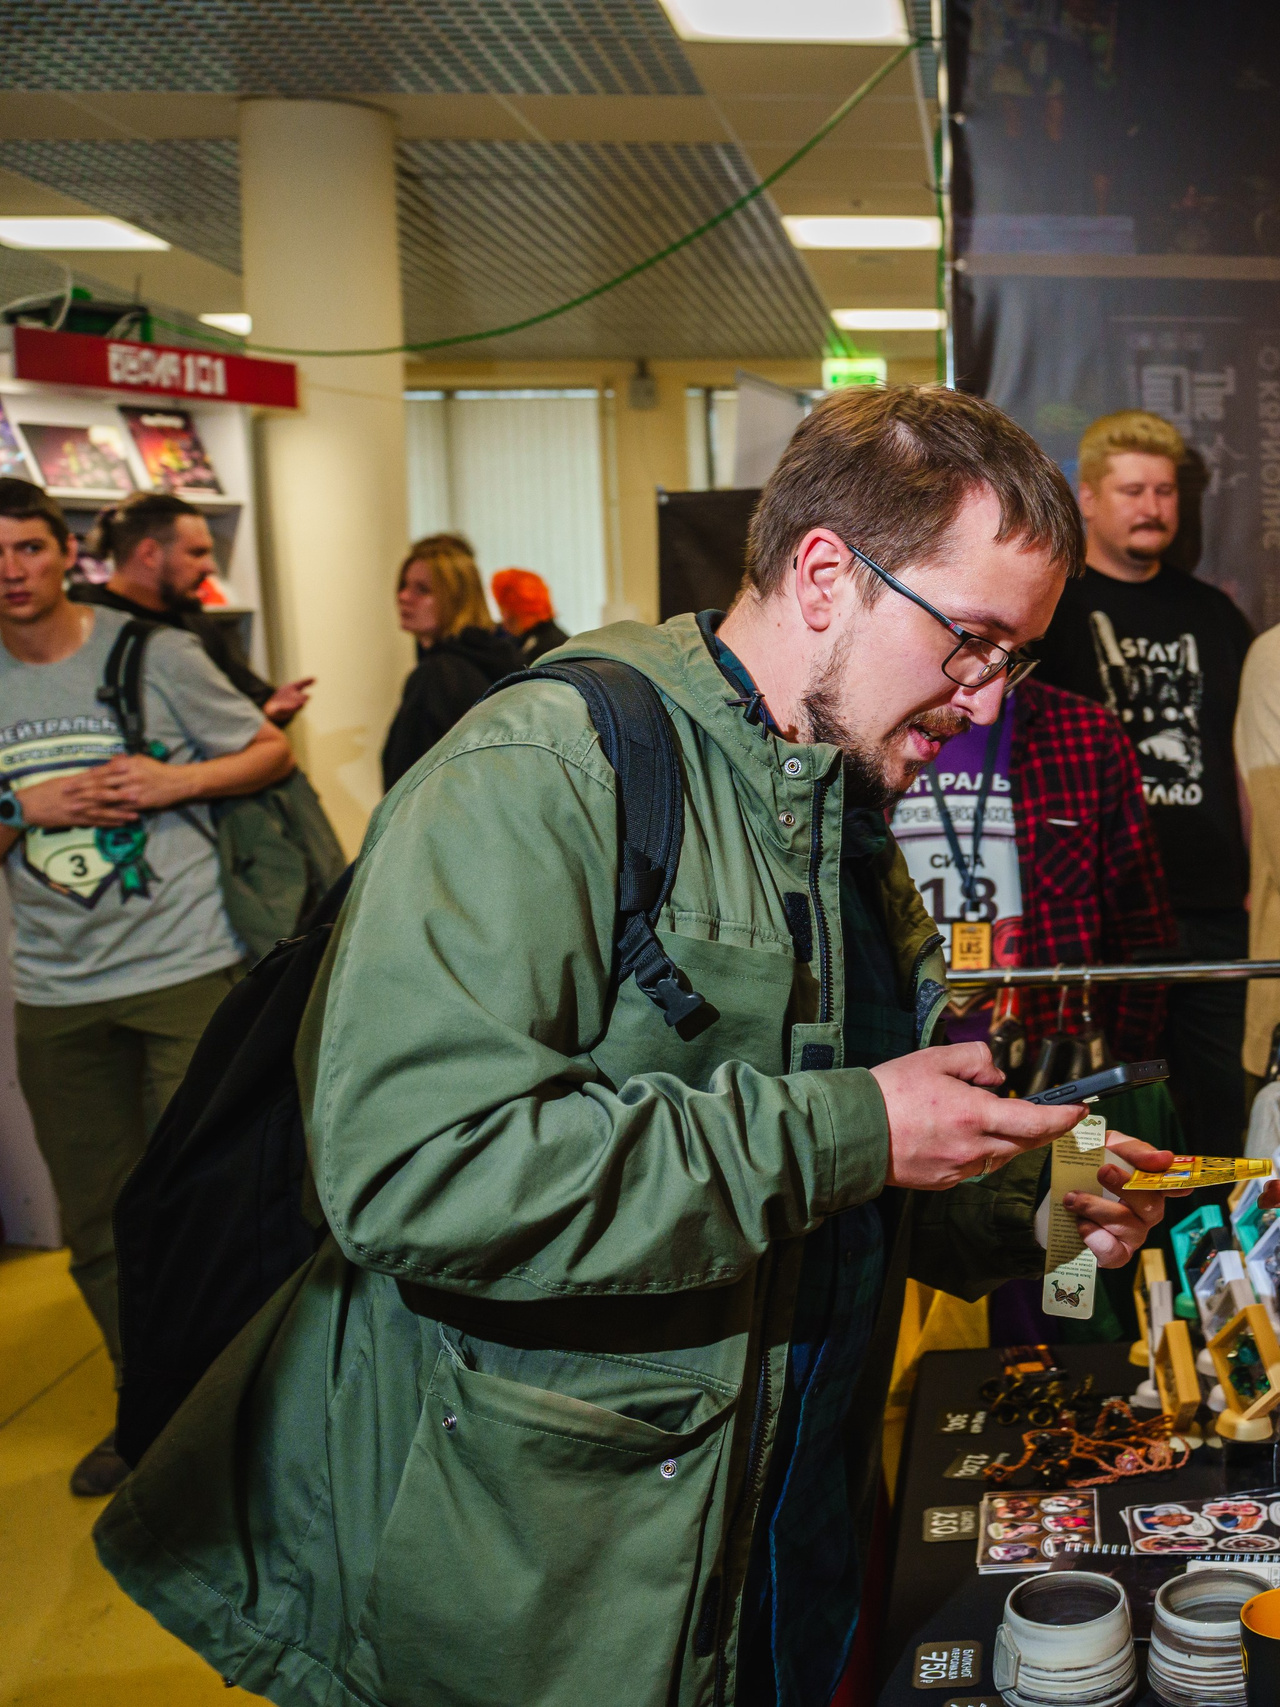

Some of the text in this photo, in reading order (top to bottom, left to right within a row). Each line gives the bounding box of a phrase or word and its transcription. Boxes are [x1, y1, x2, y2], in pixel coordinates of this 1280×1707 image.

[1120, 637, 1180, 663] STAY
[70, 855, 88, 877] 3
[920, 878, 999, 924] 18
[961, 1648, 974, 1679] БЛОКНОТ
